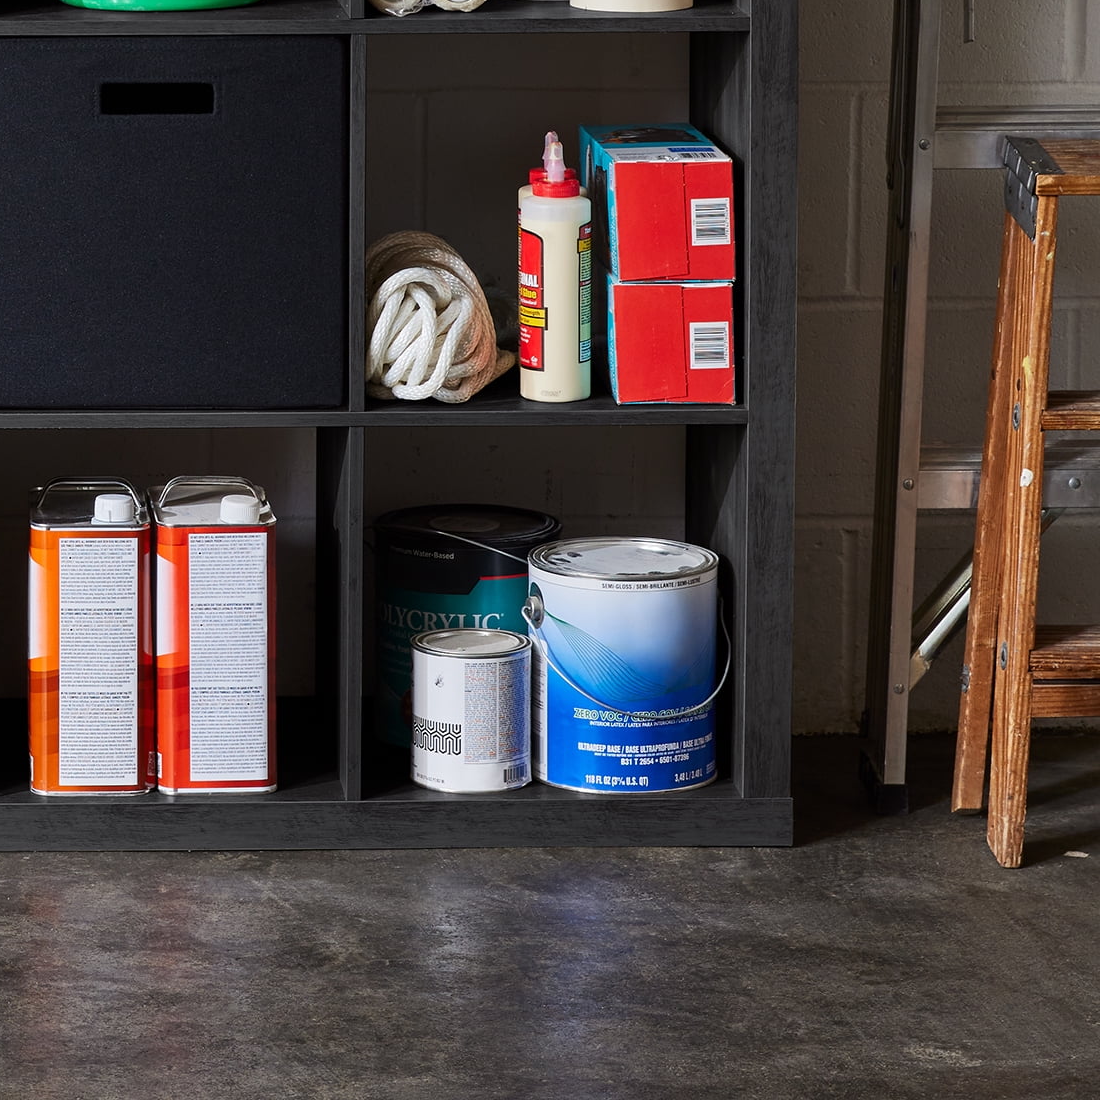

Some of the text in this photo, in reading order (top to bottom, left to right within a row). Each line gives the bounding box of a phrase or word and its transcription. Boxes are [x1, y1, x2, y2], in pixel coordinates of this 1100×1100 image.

[412, 549, 456, 561] Water-Based
[573, 707, 599, 720] ZERO
[599, 709, 623, 722] VOC
[577, 742, 607, 752] ULTRADEEP
[607, 744, 621, 753] BASE
[625, 744, 639, 754] BASE
[603, 775, 611, 785] OZ
[626, 776, 639, 786] U.S.
